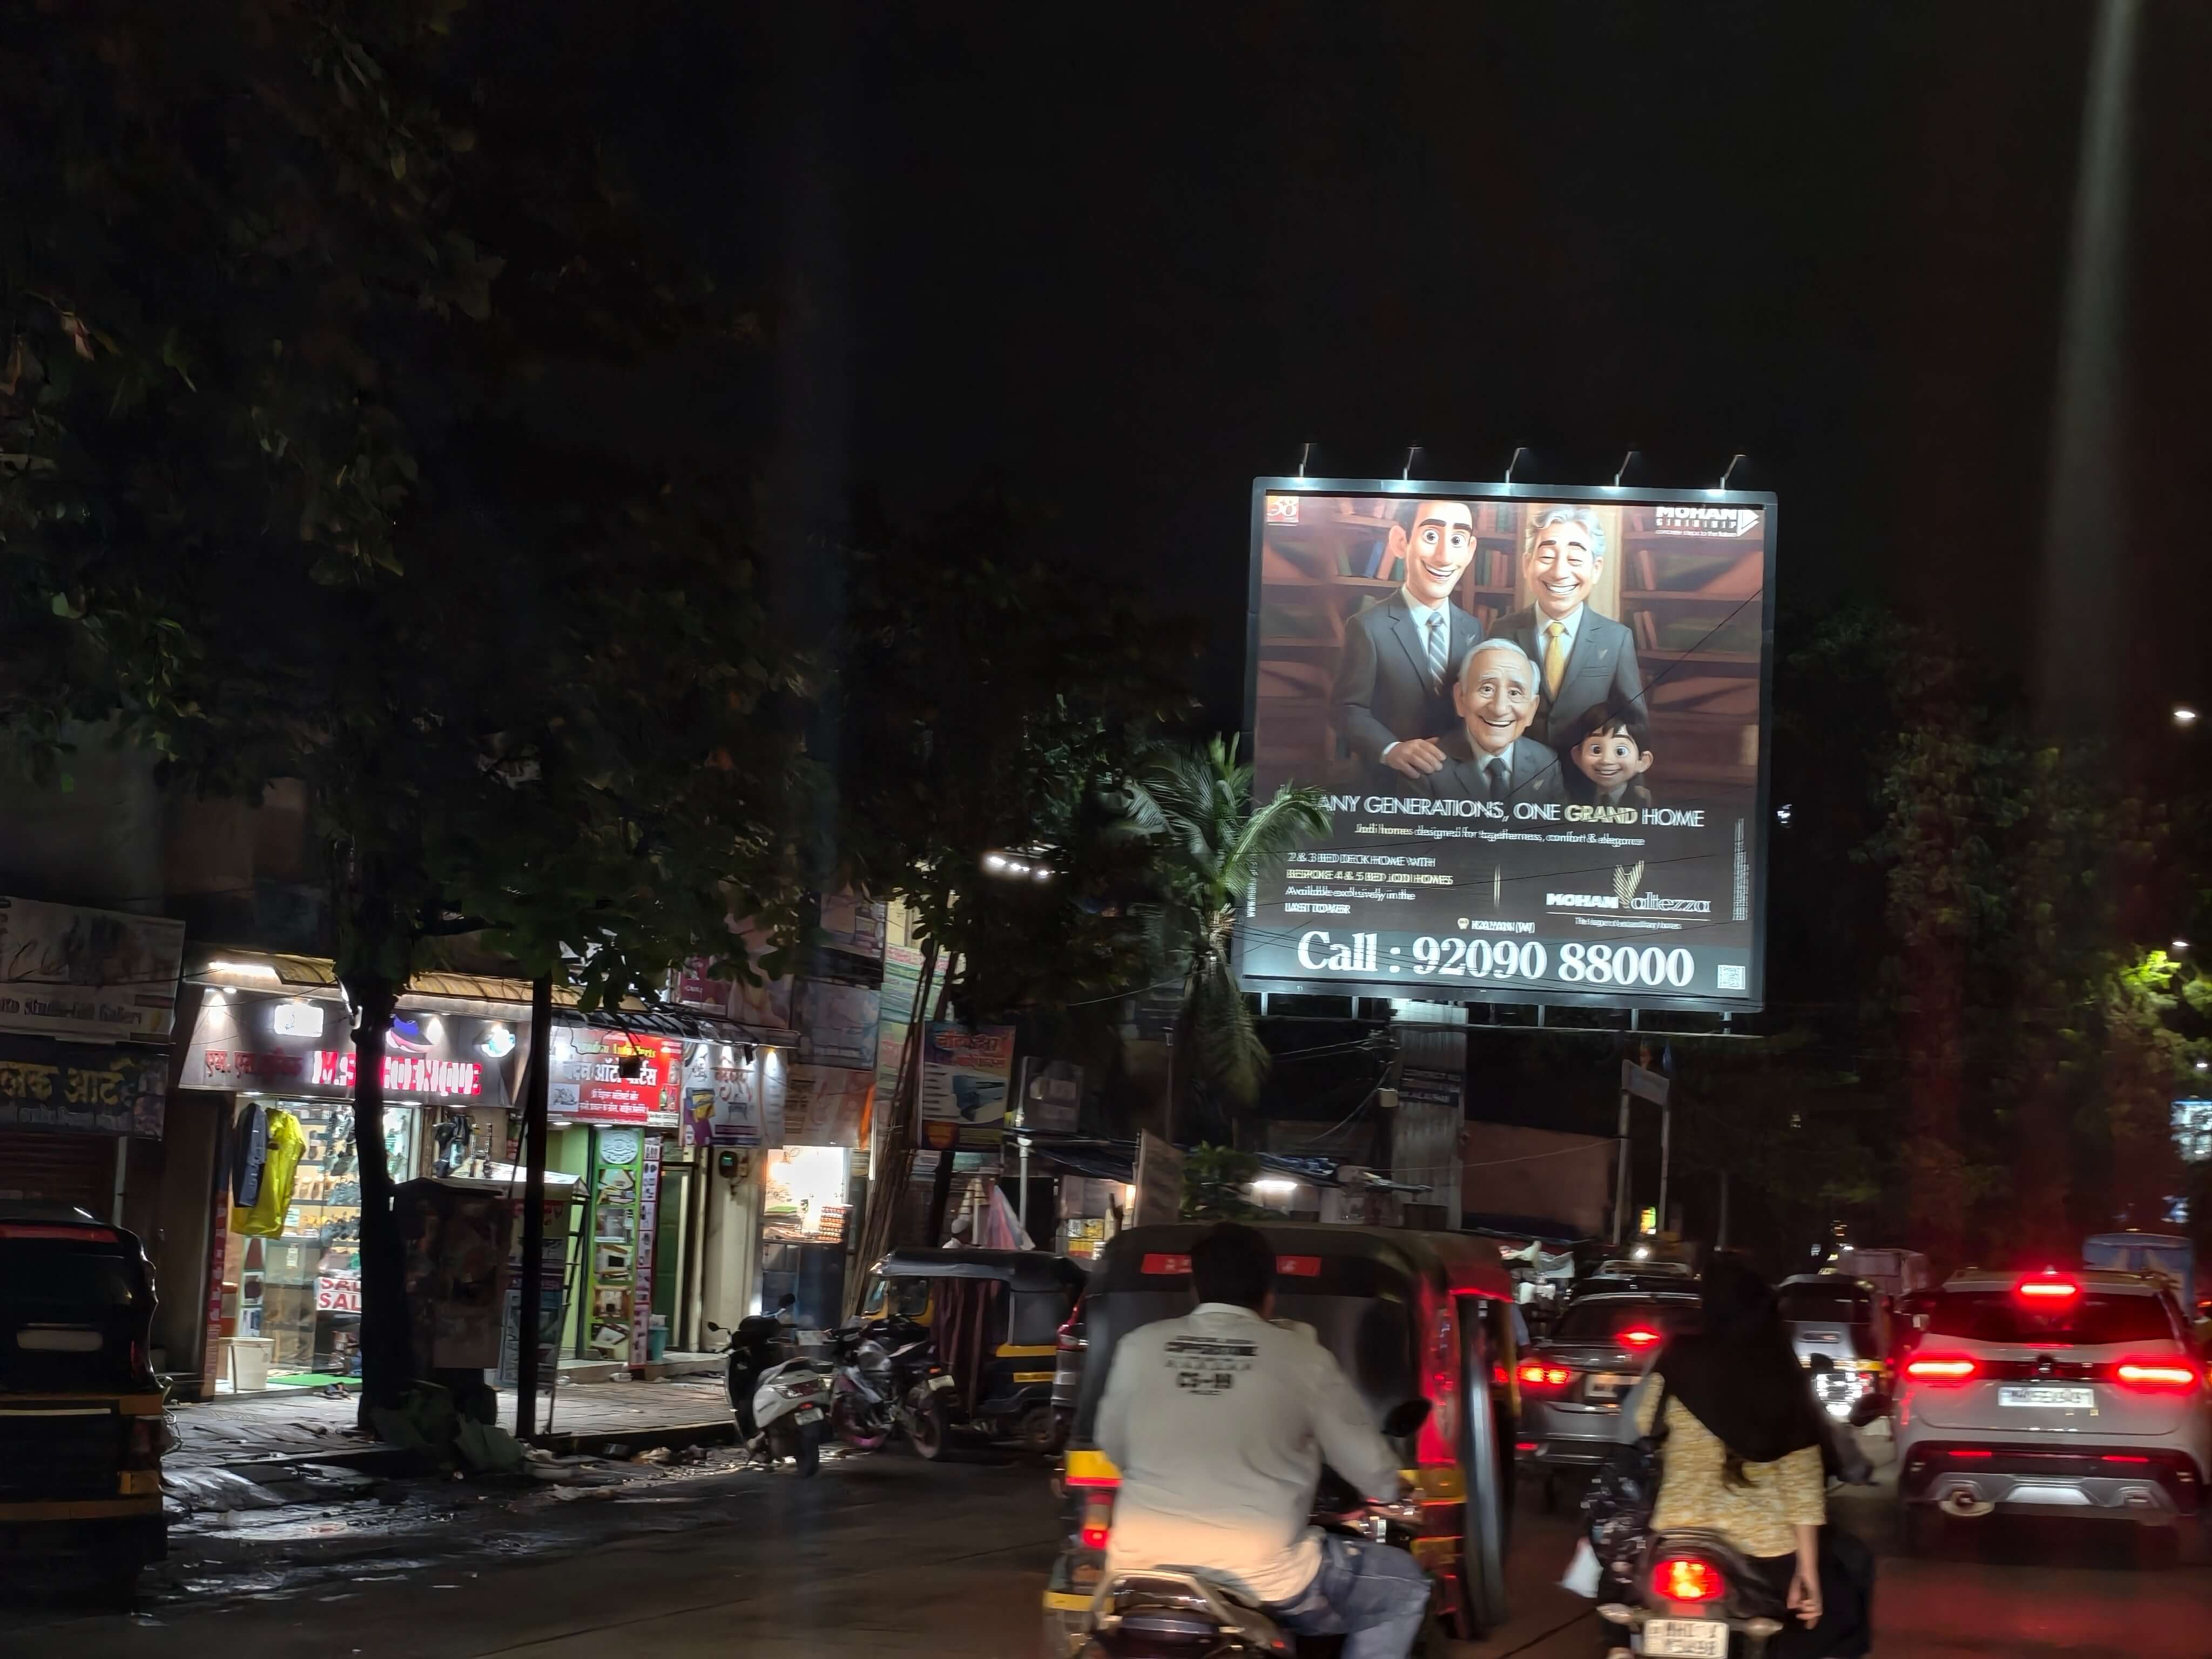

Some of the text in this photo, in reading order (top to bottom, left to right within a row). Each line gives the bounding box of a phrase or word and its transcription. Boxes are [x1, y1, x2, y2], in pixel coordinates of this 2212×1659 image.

[1656, 507, 1737, 520] MOHAN
[1317, 794, 1705, 827] ANY GENERATIONS, ONE GRAND HOME
[1378, 824, 1413, 835] homes
[1415, 825, 1461, 839] designed
[1587, 833, 1597, 843] &
[1598, 833, 1645, 847] elegance
[1287, 853, 1296, 862] 2
[1297, 853, 1307, 862] &
[1308, 853, 1317, 862] 3
[1318, 854, 1339, 864] BED
[1334, 871, 1343, 880] 4
[1344, 871, 1354, 881] &
[1354, 872, 1364, 881] 5
[1546, 892, 1711, 913] MOHAN altezza
[1297, 930, 1695, 987] Call : 92090 88000
[321, 1278, 361, 1292] SAL
[319, 1293, 361, 1311] SAL
